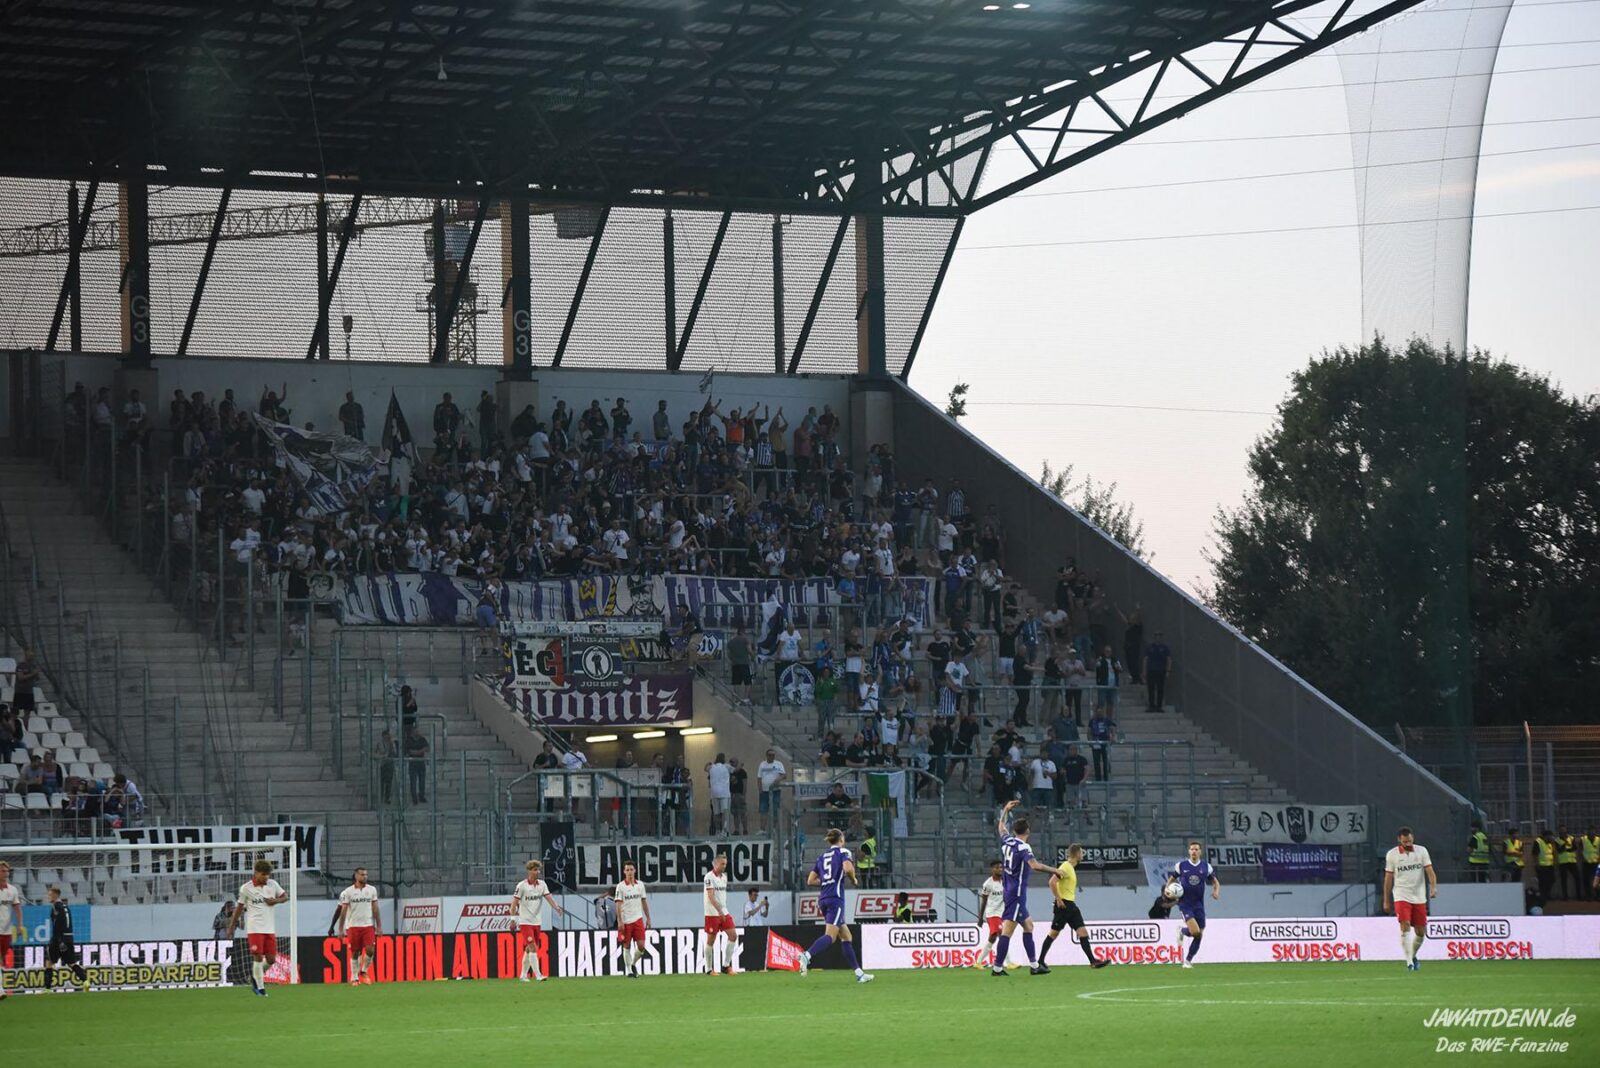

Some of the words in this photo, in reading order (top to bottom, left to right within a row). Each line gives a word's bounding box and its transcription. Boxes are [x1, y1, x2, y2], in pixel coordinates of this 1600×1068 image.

[117, 825, 318, 874] THALHEIM
[1058, 848, 1100, 861] SEPER
[1103, 847, 1137, 860] FIDELIS
[1207, 846, 1263, 865] PLAUEN
[823, 856, 833, 880] 5
[405, 907, 437, 917] TRANSPORTE
[467, 904, 520, 916] TRANSP
[860, 896, 930, 913] ES-E
[467, 917, 520, 931] Müll
[1254, 924, 1333, 938] FAHRSCHULE
[1430, 922, 1507, 937] FAHRSCHULE
[893, 931, 976, 945] FAHRSCHULE
[1076, 927, 1156, 941] HRSCHULE
[452, 933, 488, 981] AN
[557, 928, 746, 977] HAFESTRAE
[1094, 945, 1183, 964] SKUBSCH
[1272, 942, 1361, 962] SKUBSCH
[1447, 940, 1533, 960] SKUBSCH
[1, 964, 222, 990] EAMSPORTBEDARF.DE
